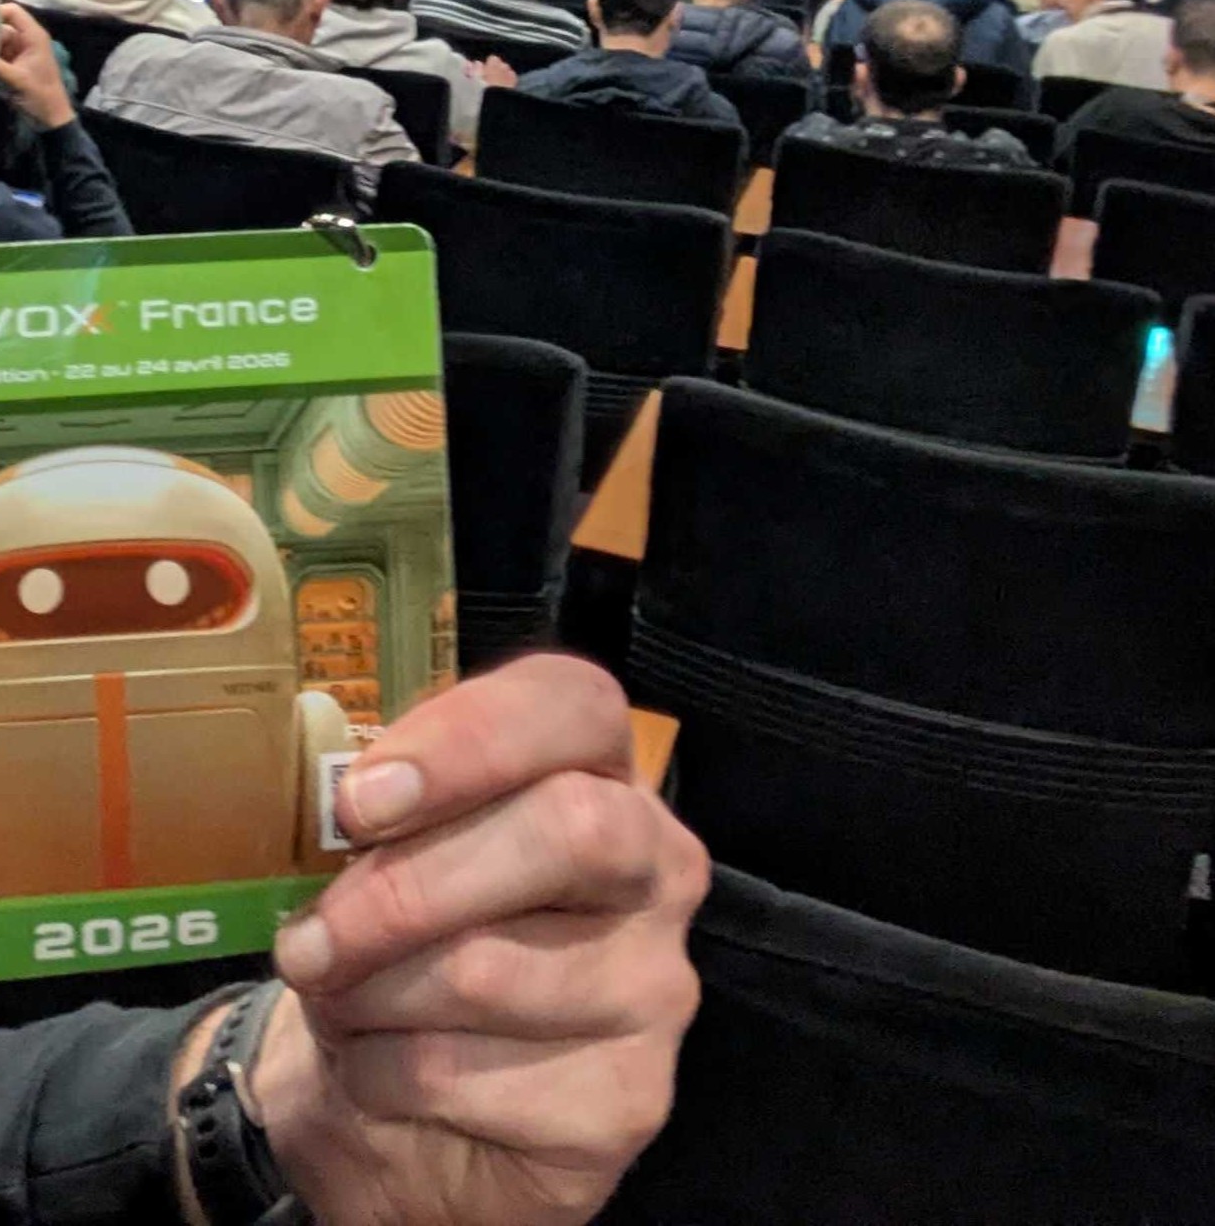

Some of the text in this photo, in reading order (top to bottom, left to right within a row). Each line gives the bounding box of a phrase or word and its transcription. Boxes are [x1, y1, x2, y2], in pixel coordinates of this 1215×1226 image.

[139, 296, 318, 332] France
[65, 364, 95, 380] 22
[101, 364, 132, 378] au
[136, 359, 170, 375] 24
[173, 355, 224, 373] avril
[227, 351, 291, 370] 2026
[34, 910, 219, 960] 2026
